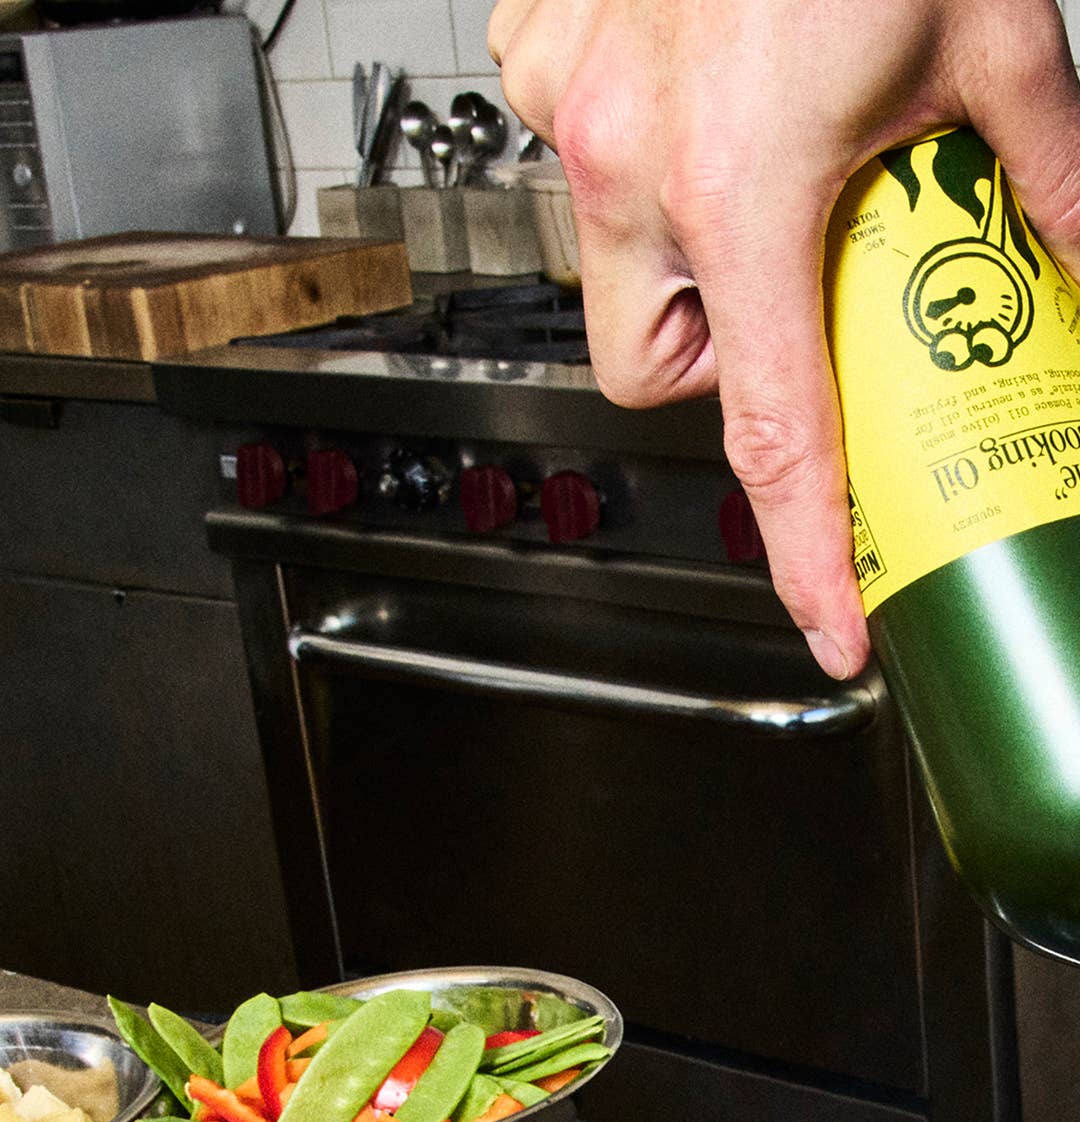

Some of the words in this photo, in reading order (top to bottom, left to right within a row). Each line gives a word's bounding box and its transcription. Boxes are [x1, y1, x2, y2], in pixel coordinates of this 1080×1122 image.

[847, 209, 880, 231] POINT
[849, 222, 886, 243] SMOKE
[993, 372, 1041, 389] baking,
[963, 385, 987, 402] and
[1018, 391, 1026, 399] a
[1030, 387, 1044, 397] as
[910, 395, 958, 418] frying.
[966, 393, 1013, 417] neutral
[1008, 406, 1030, 420] Oil
[1034, 398, 1073, 411] Pomace
[940, 411, 960, 427] oil
[961, 412, 1000, 433] (olive
[914, 422, 934, 436] for
[921, 430, 956, 451] mush)
[931, 457, 979, 503] Oil
